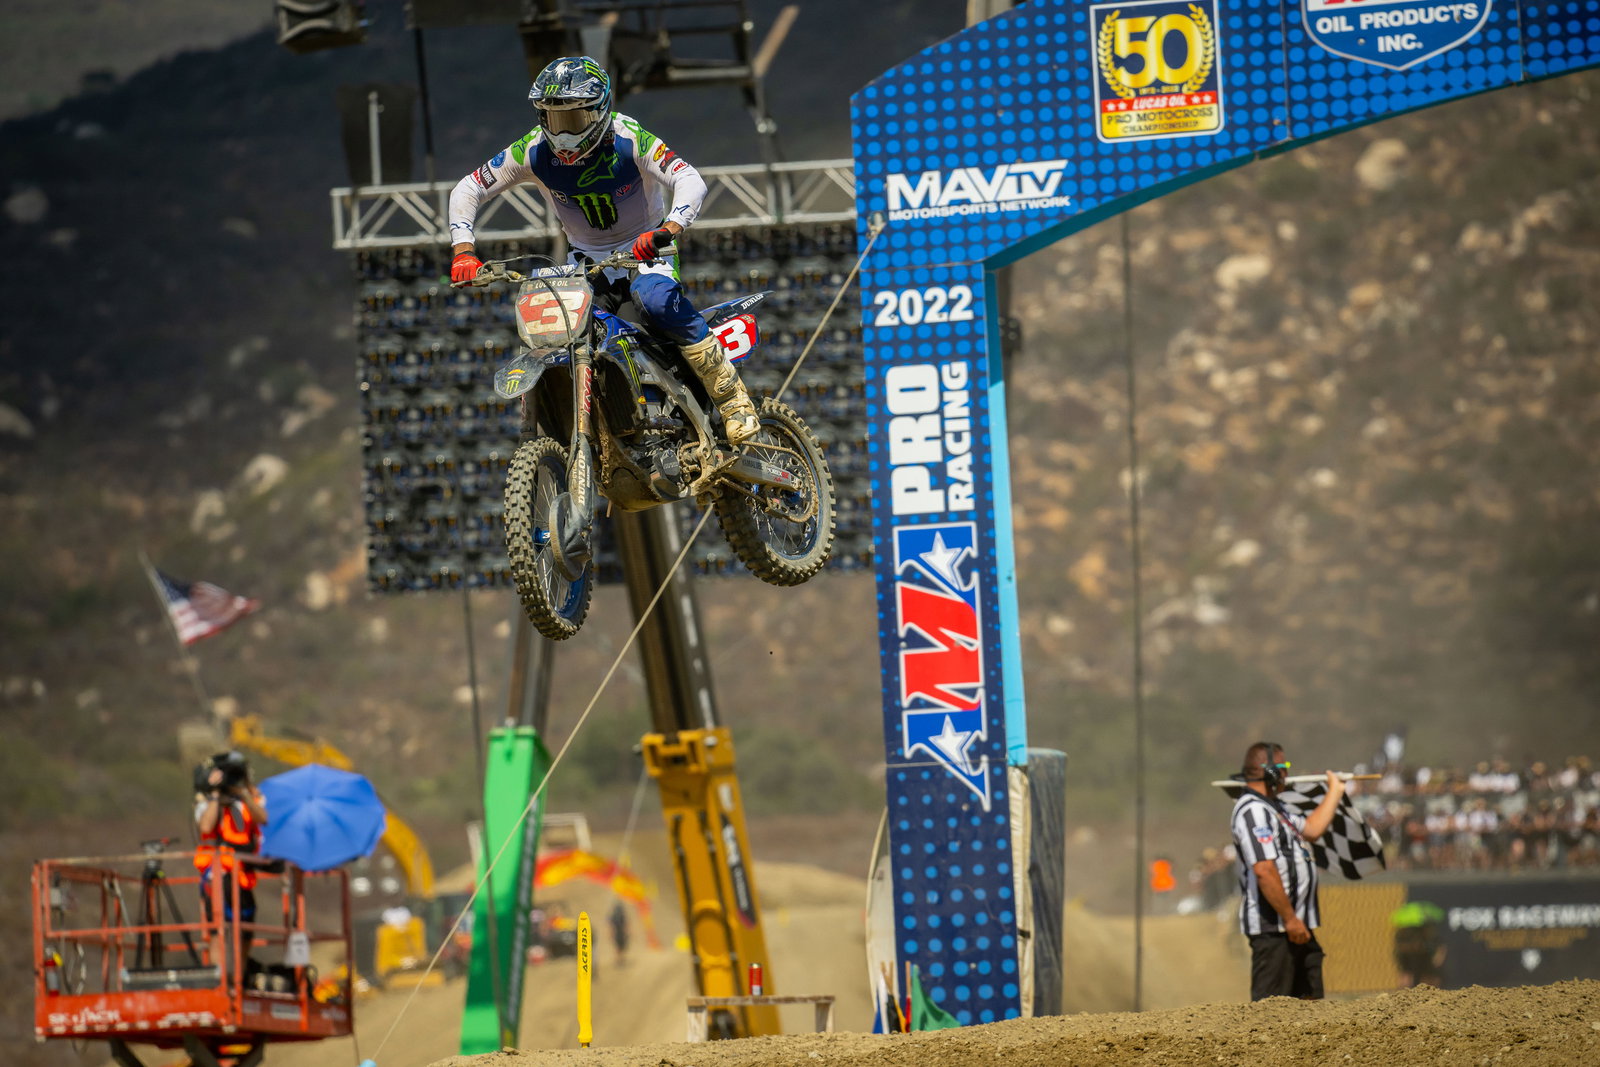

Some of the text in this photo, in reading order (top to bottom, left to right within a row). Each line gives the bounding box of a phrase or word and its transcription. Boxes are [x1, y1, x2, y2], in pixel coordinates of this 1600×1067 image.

[1316, 3, 1479, 34] OIL PRODUCTS
[1113, 13, 1204, 89] 50
[1107, 106, 1213, 125] PRO MOTOCROSS
[1132, 94, 1188, 111] LUCAS OIL
[1122, 121, 1199, 133] CHAMPIONSHIP
[889, 196, 1072, 221] MOTORSPORTS NETWORK
[525, 291, 586, 335] 3
[874, 285, 974, 326] 2022
[709, 318, 752, 362] 3
[885, 364, 945, 516] PRO
[941, 361, 975, 512] RACING
[578, 449, 586, 506] DUNLOP
[1448, 906, 1496, 931] FOX
